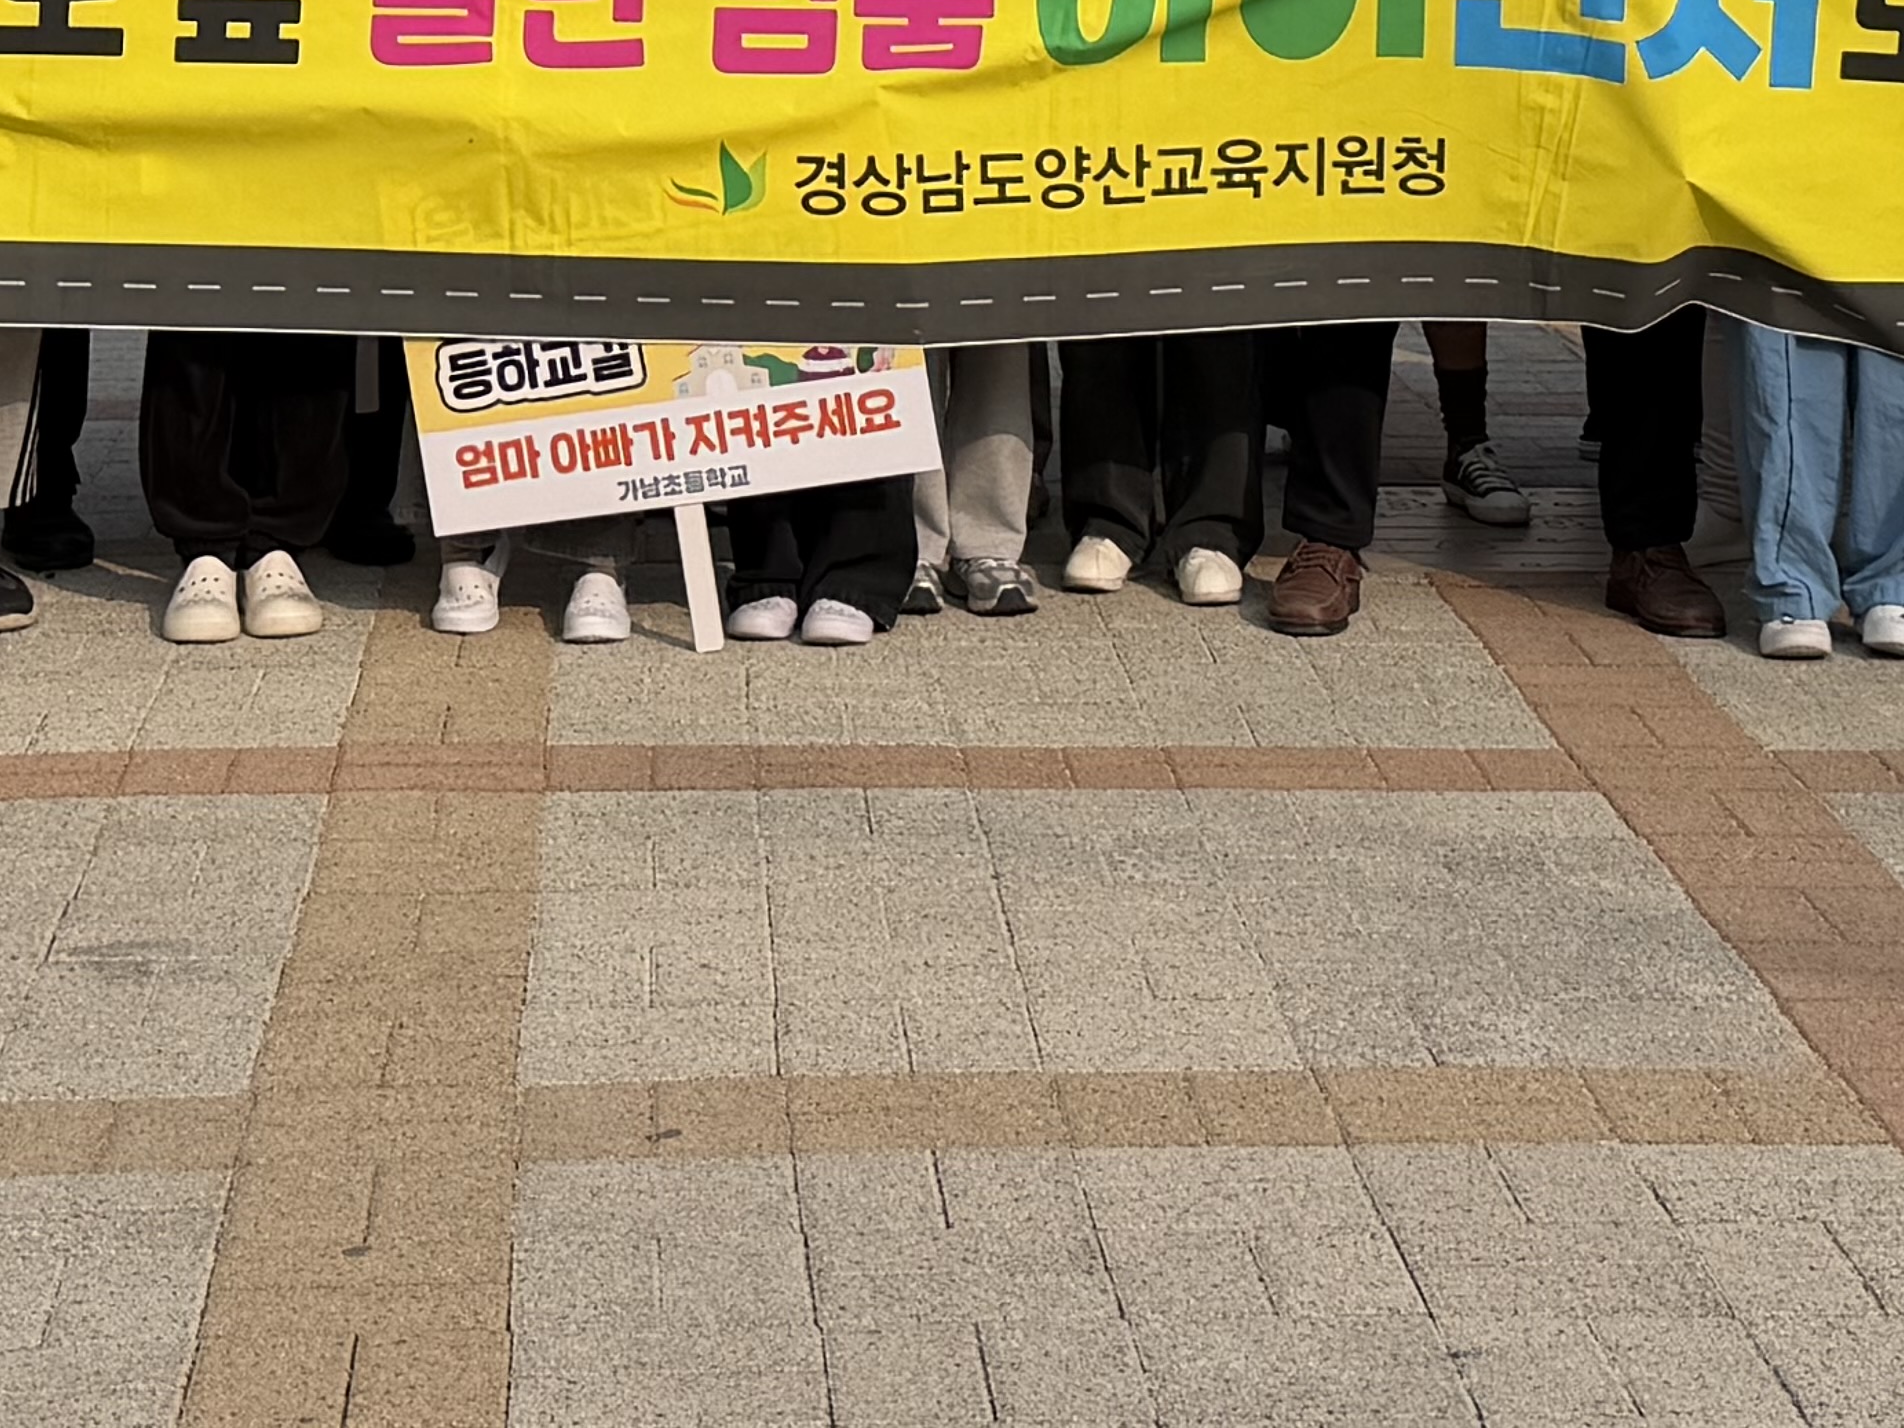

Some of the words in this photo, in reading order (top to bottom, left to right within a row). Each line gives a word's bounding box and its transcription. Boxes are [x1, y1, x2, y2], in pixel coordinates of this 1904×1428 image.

[794, 135, 1447, 216] 경상남도양산교육지원청
[455, 435, 541, 489] 엄마
[551, 417, 675, 474] 아빠가
[688, 388, 901, 457] 지켜주세요
[617, 465, 751, 502] 가남초등학교
